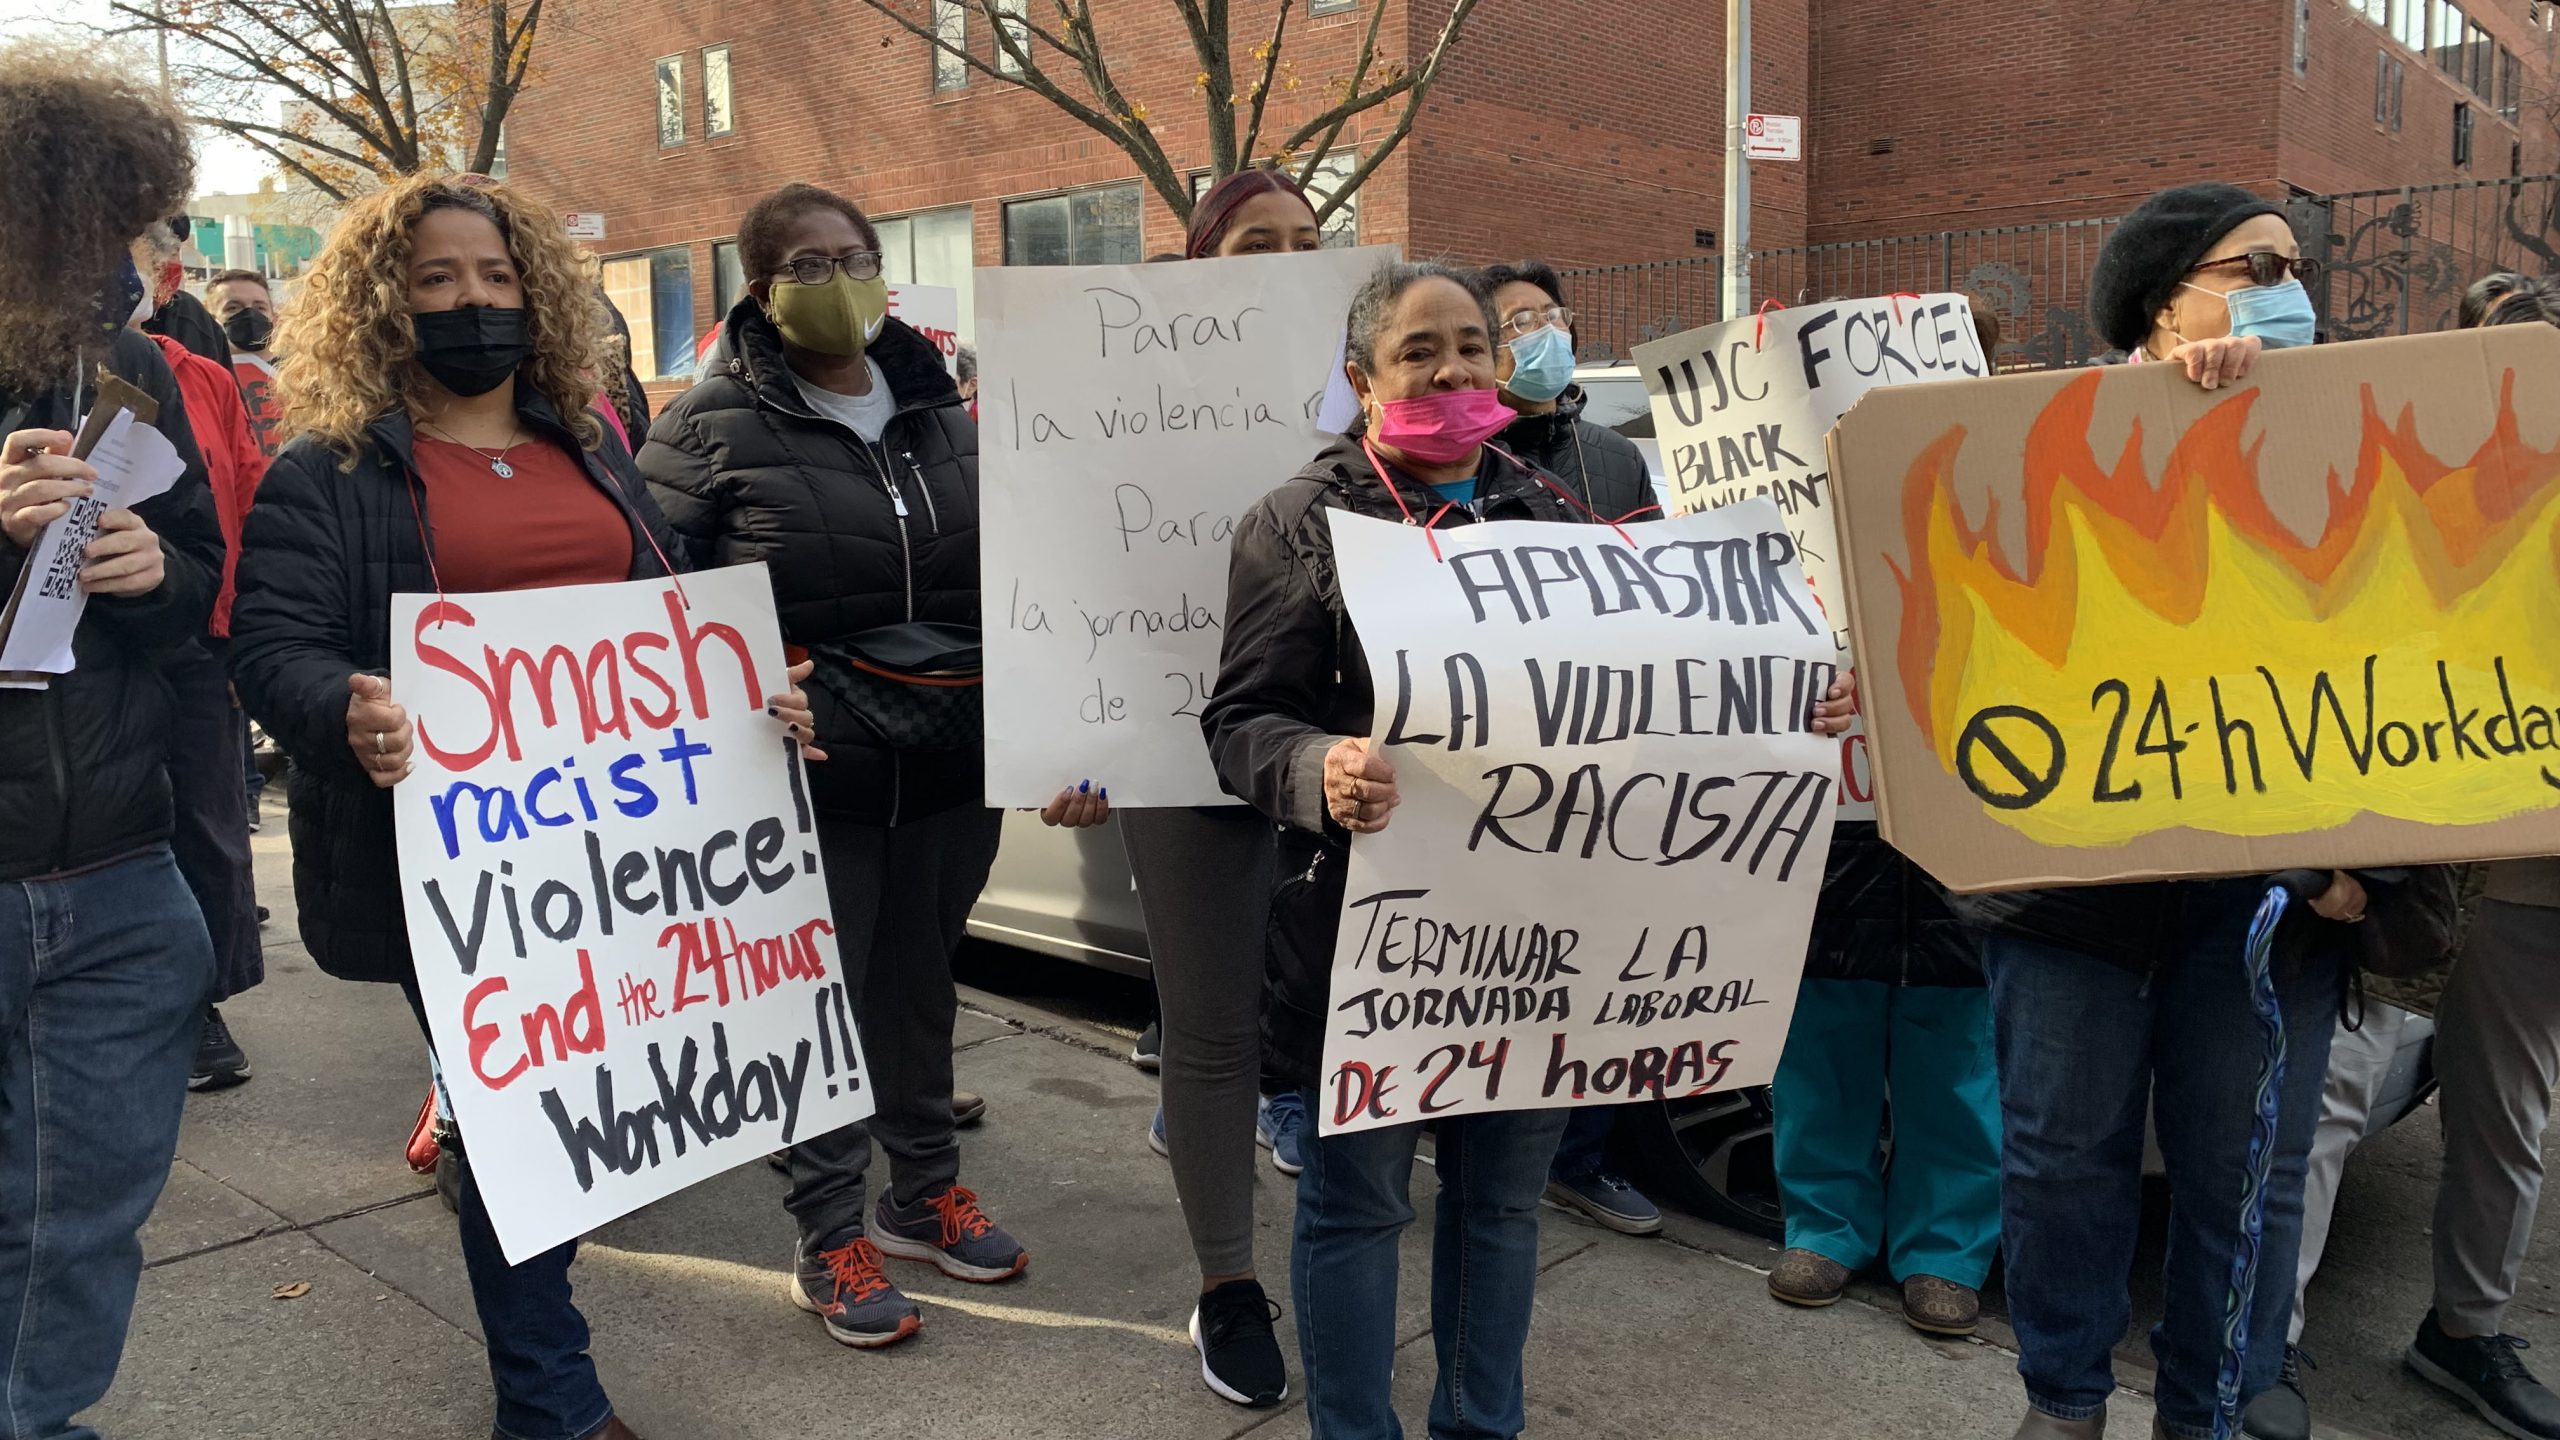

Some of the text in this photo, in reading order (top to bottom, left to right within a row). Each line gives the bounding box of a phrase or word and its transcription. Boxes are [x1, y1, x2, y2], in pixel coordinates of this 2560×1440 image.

[1083, 287, 1263, 357] Parar
[1798, 302, 1980, 390] FORCES
[1011, 378, 1075, 450] la
[1095, 385, 1288, 438] violencia
[1672, 423, 1808, 495] BLACK
[1115, 483, 1234, 553] Para
[1010, 578, 1222, 663] la jornada
[1449, 532, 1818, 634] APLASTAR
[415, 590, 762, 771] Smash
[1079, 678, 1127, 724] de
[1385, 650, 1489, 751] LA
[1525, 657, 1838, 747] VIOLENCIA
[430, 728, 712, 860] racist
[1467, 763, 1831, 882] RACISTA
[422, 736, 817, 975] Violence!
[1349, 889, 1707, 982] TERMINAR LA
[463, 949, 605, 1090] End
[617, 972, 664, 1026] the
[1338, 979, 1770, 1039] JORNADA LABORAL
[1330, 1060, 1399, 1126] DE
[1414, 1037, 1511, 1114] 24
